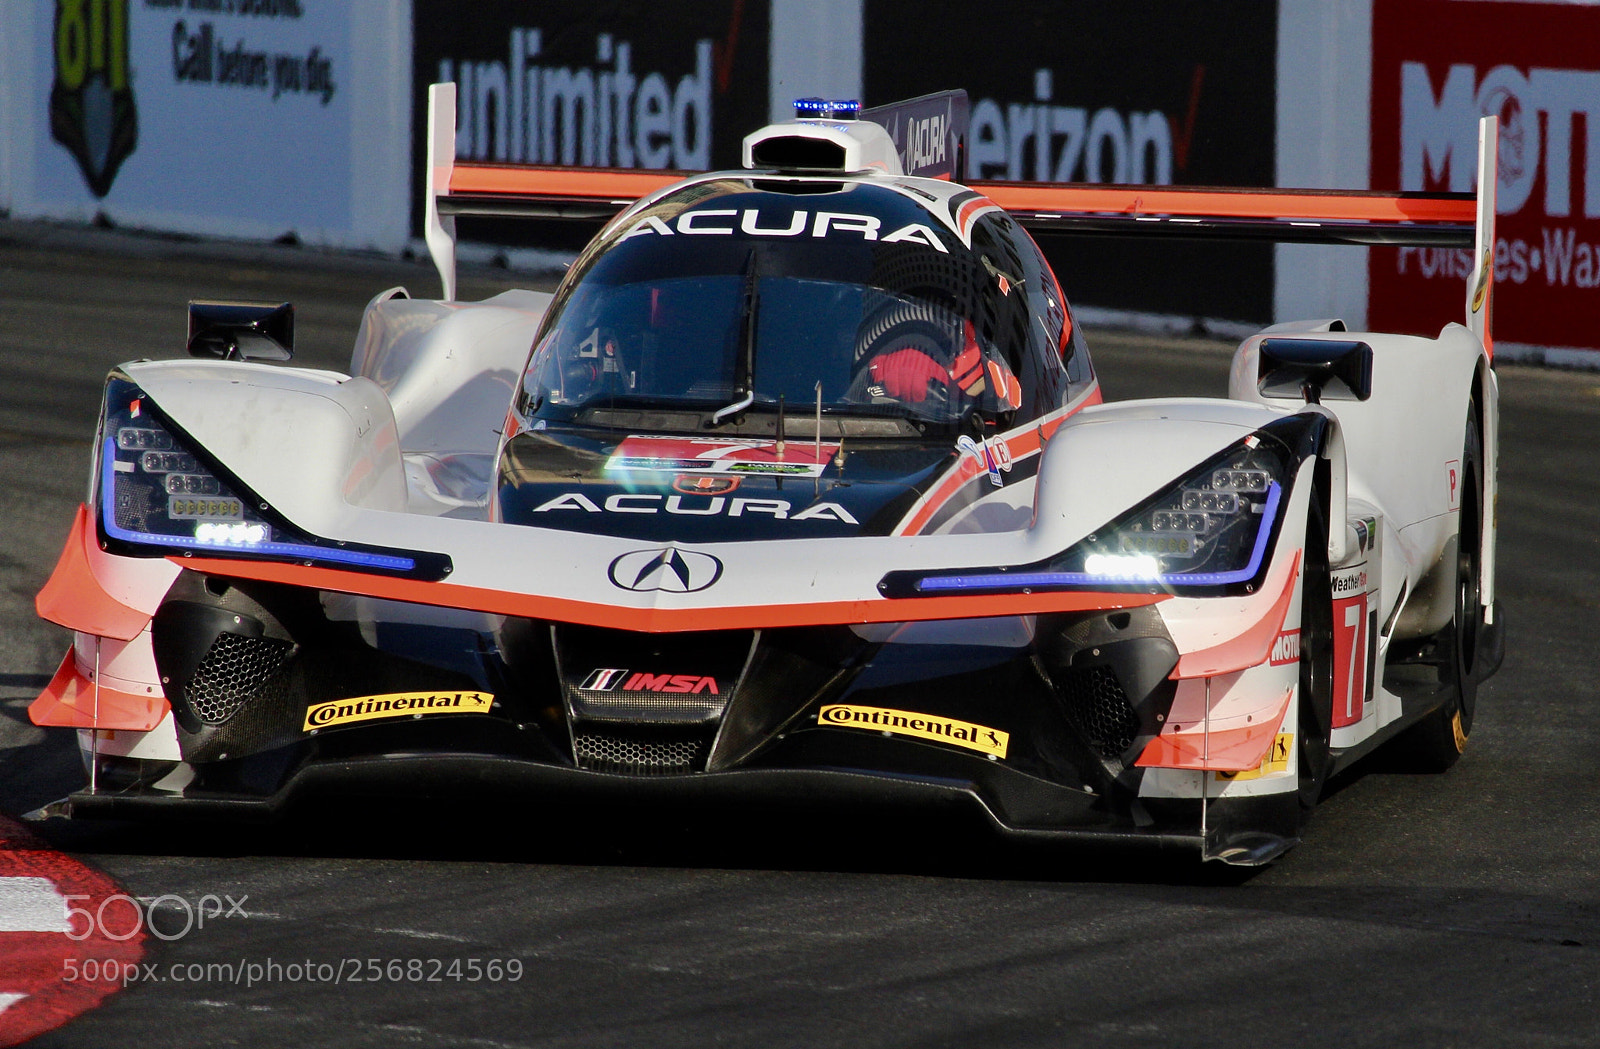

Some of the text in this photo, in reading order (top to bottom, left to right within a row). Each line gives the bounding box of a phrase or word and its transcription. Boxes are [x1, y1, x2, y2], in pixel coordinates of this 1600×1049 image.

[172, 20, 213, 82] Call
[440, 27, 712, 170] unlimited
[914, 114, 946, 169] ACURA
[969, 68, 1173, 186] erizon
[615, 209, 949, 254] ACURA
[690, 440, 773, 459] 7
[995, 442, 1009, 464] E
[1449, 468, 1456, 503] P
[533, 493, 859, 525] ACURA
[1345, 603, 1361, 718] 7
[622, 673, 719, 695] IMSA
[307, 694, 462, 726] Continental
[822, 707, 978, 743] Continental
